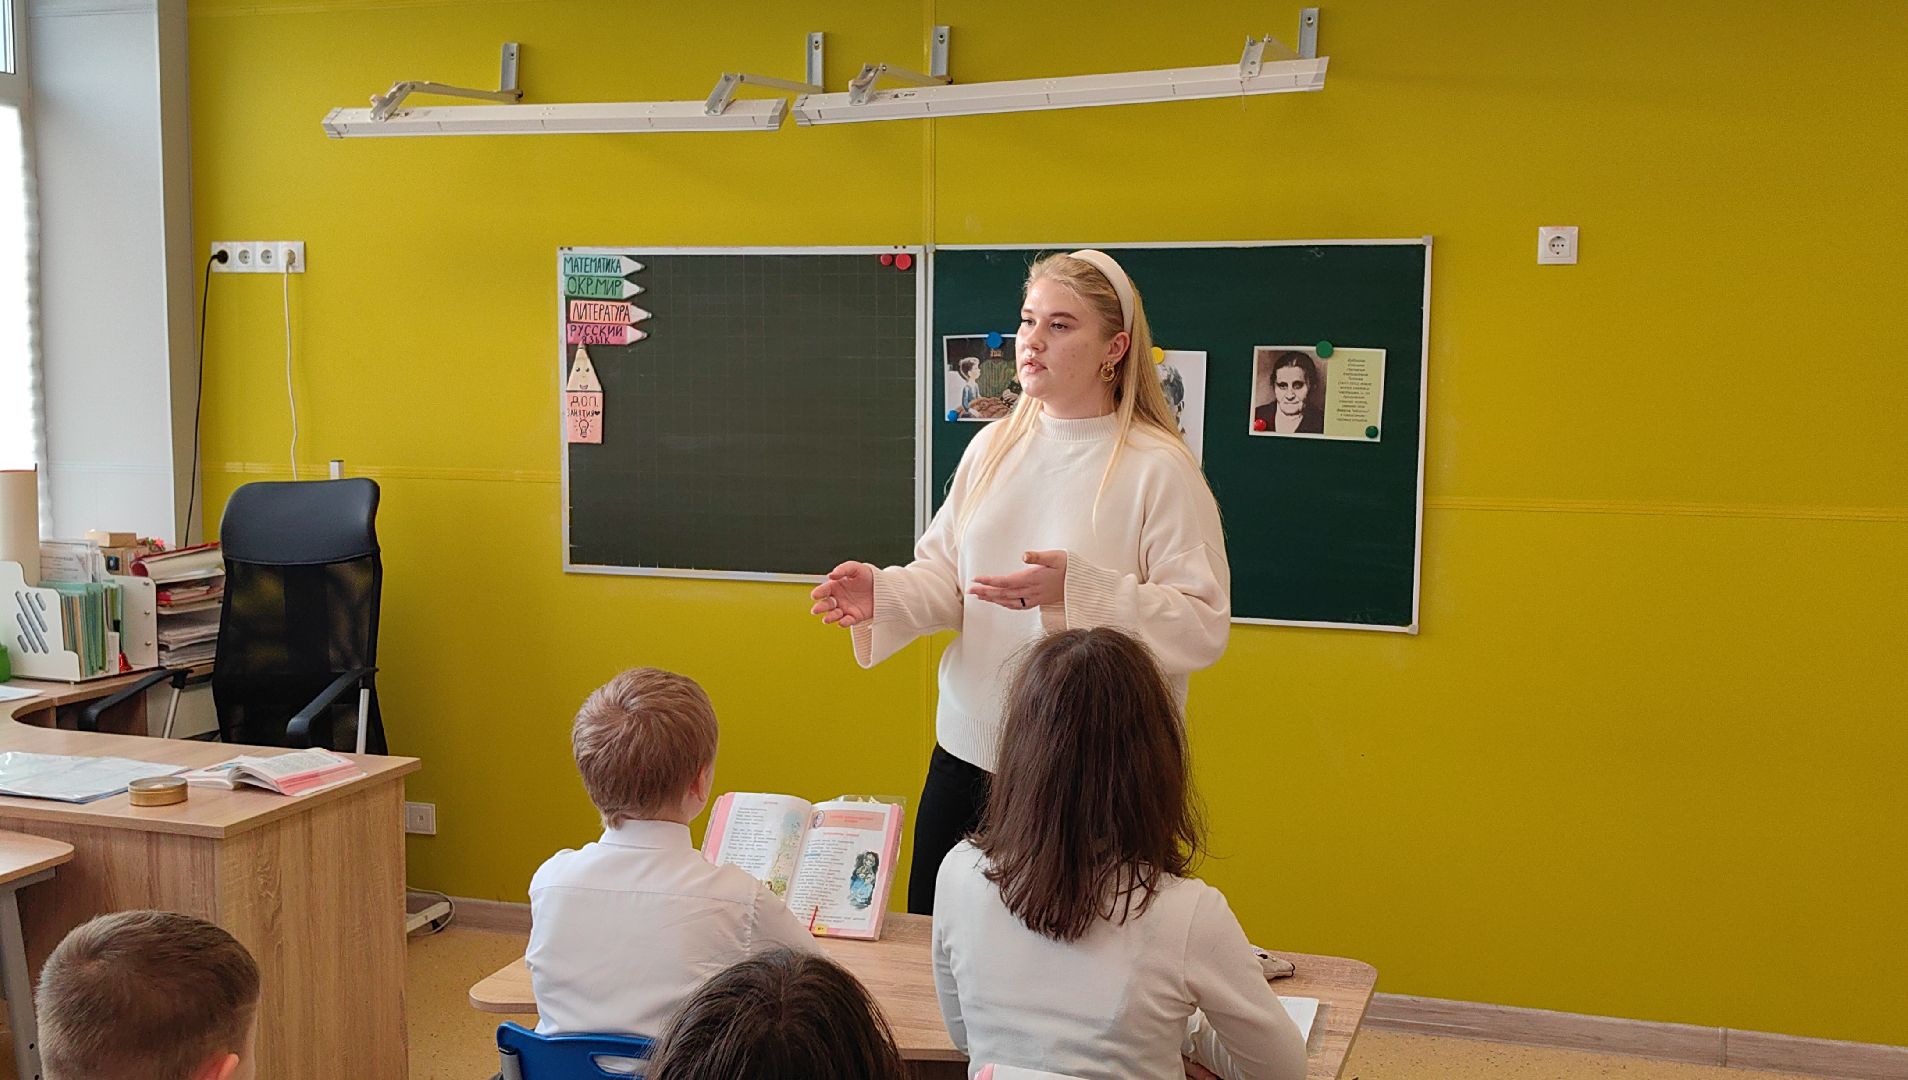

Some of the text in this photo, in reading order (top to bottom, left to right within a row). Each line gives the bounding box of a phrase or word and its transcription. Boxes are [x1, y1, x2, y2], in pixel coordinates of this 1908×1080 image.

[564, 257, 622, 273] МАТЕМАТИКА
[573, 303, 630, 322] ЛИТЕРАТУРА
[581, 335, 610, 345] ЯЗЫК
